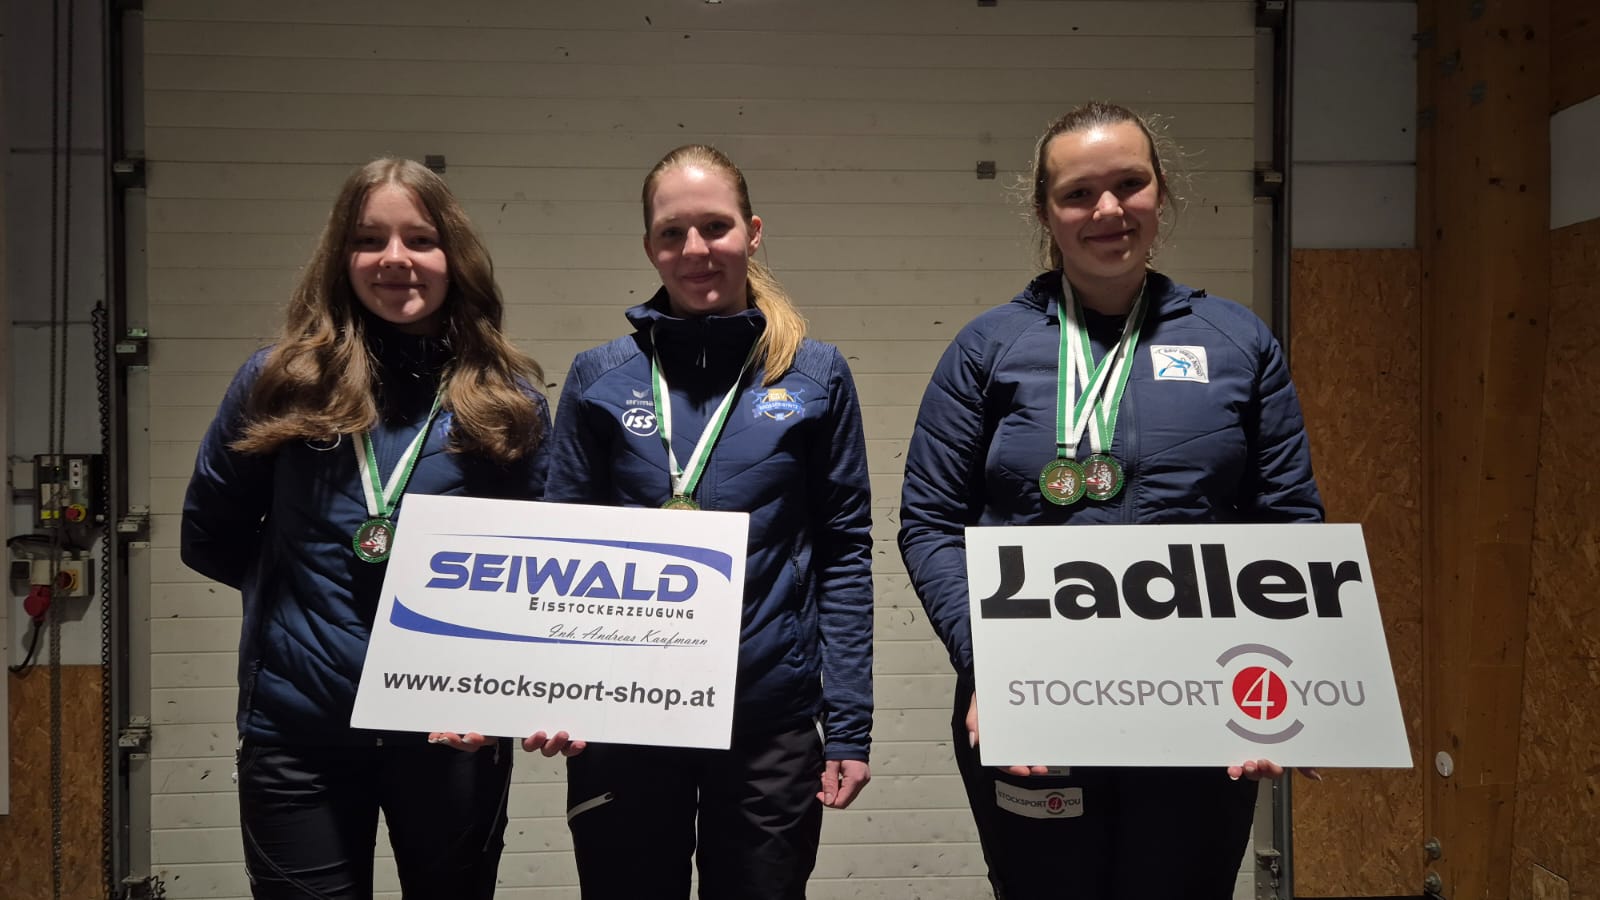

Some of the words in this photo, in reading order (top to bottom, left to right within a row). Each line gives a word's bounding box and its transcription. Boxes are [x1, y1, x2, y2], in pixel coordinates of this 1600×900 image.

[626, 415, 655, 429] ISS
[425, 551, 698, 602] SEIWALD
[980, 543, 1362, 620] Ladler
[529, 597, 694, 619] EISSTOCKERZEUGUNG
[549, 624, 576, 639] Inh.
[582, 626, 636, 643] Andreas
[640, 629, 708, 648] Kaufmann
[383, 672, 715, 710] www.stocksport-shop.at
[1008, 679, 1224, 706] STOCKSPORT
[1240, 668, 1275, 720] 4
[1290, 679, 1366, 707] YOU
[998, 791, 1047, 808] STOCKSPORT
[1063, 798, 1081, 807] YOU
